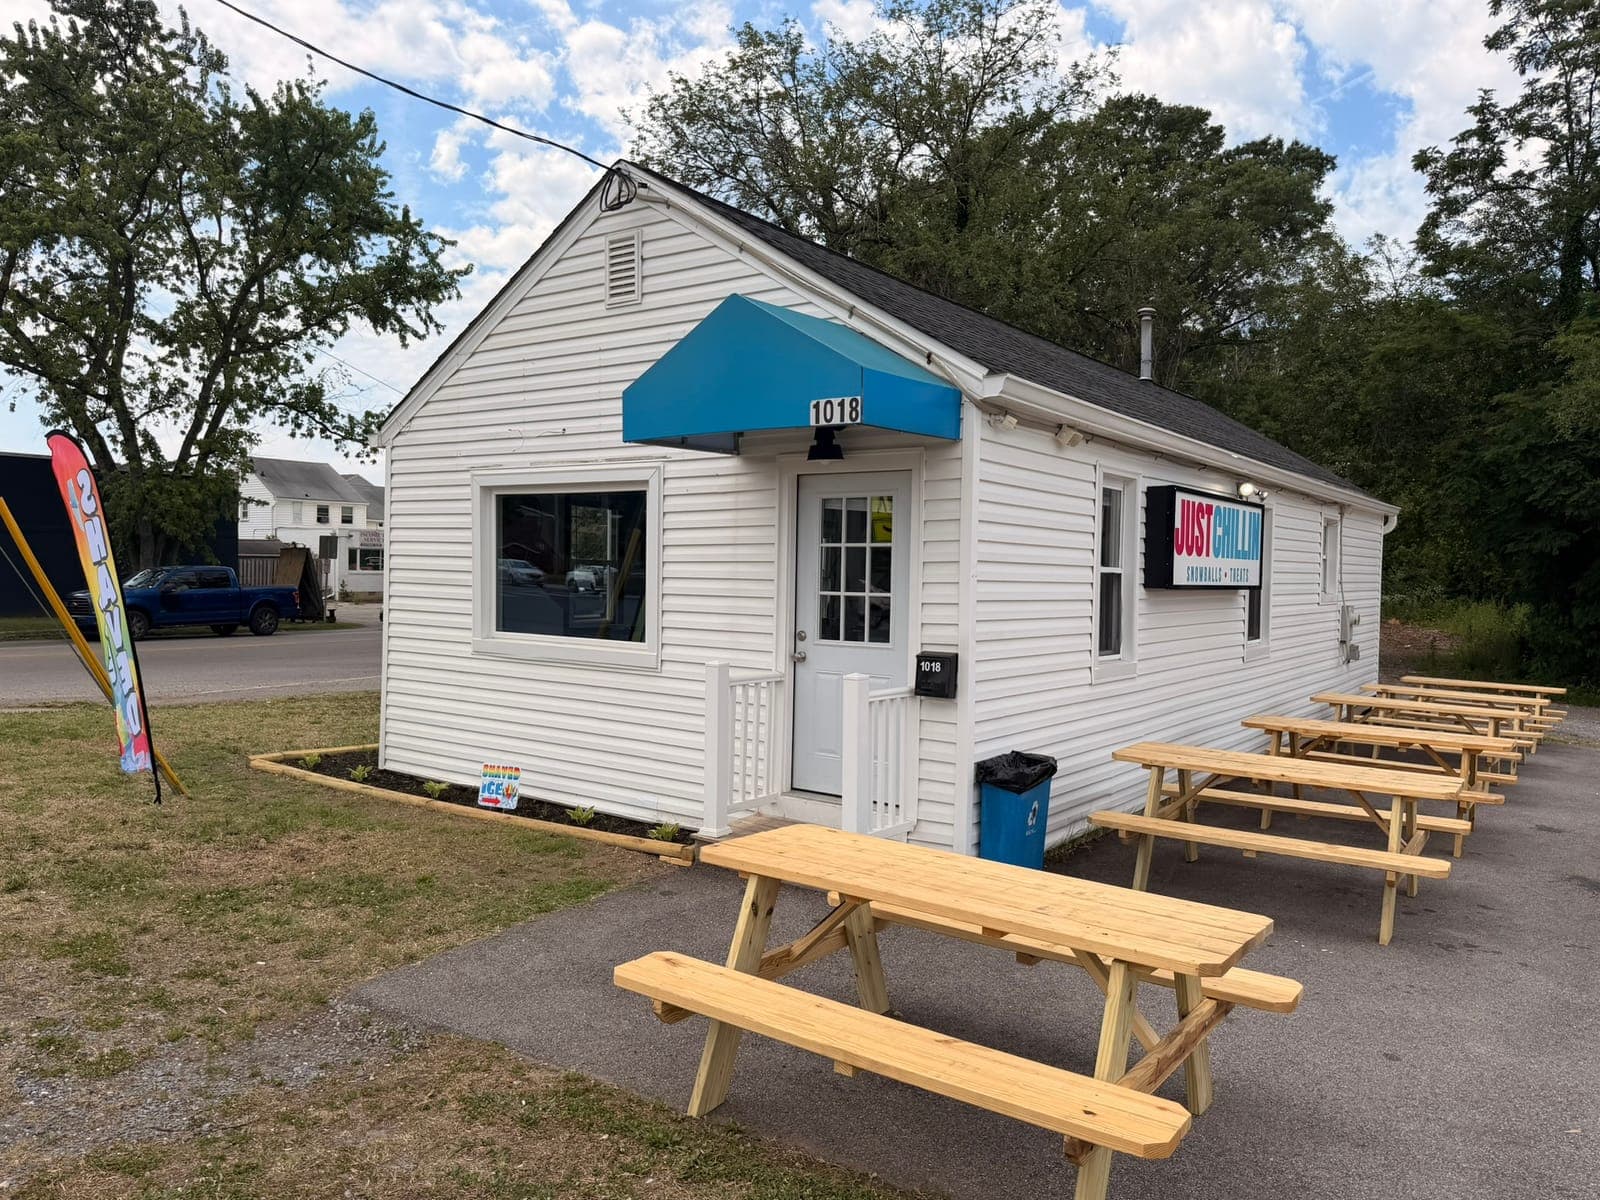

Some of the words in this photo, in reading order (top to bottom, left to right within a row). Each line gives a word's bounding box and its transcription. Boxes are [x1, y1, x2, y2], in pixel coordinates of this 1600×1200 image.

[812, 397, 860, 425] 1018
[1174, 499, 1214, 557] JUST
[1213, 505, 1260, 561] CHILLIN
[1186, 566, 1222, 583] SNOWBALLS
[1229, 567, 1249, 583] TREATS
[920, 661, 942, 672] 1018
[482, 764, 520, 780] SHAVED
[481, 781, 503, 796] ICE
